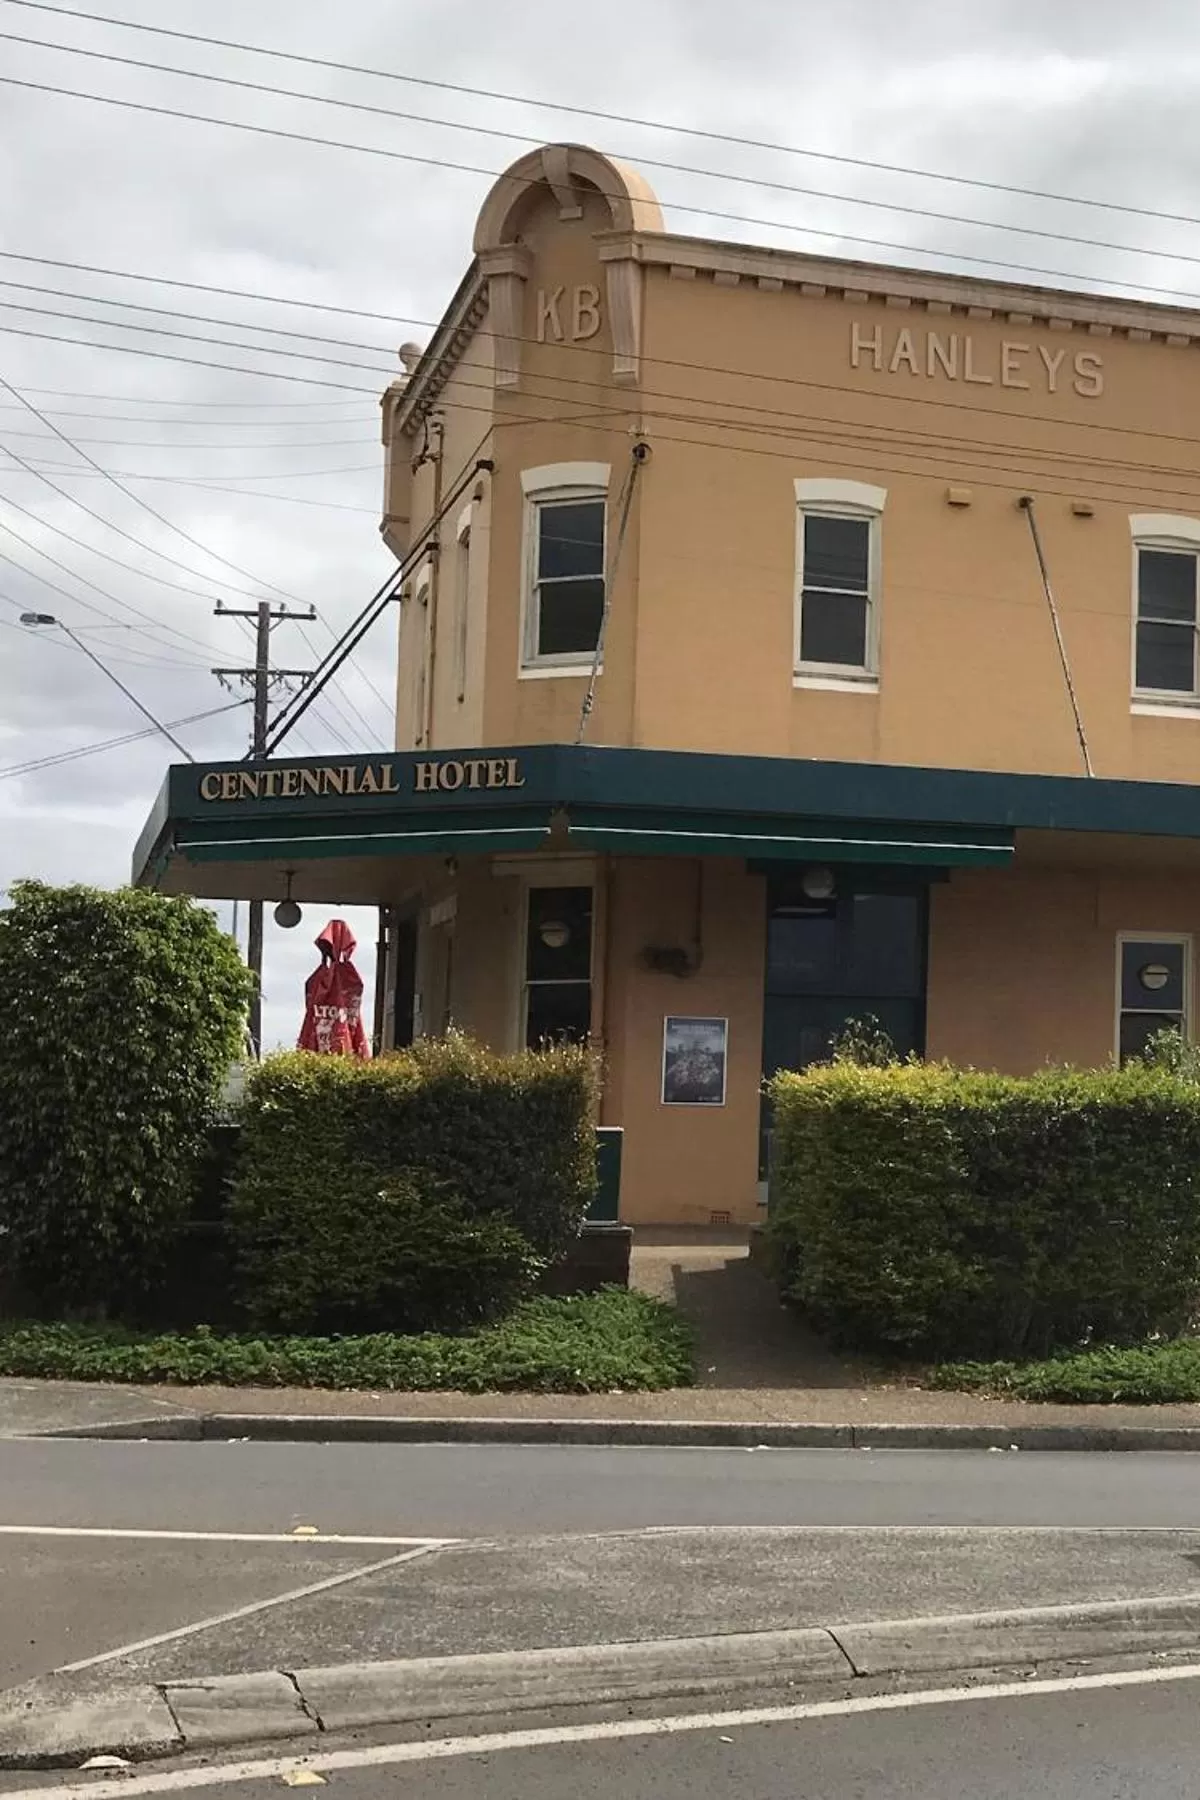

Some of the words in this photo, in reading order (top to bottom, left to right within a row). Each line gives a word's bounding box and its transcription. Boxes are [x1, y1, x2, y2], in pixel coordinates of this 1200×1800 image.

[536, 284, 600, 343] KB
[850, 321, 1104, 397] HANLEYS
[201, 764, 399, 800] CENTENNIAL
[415, 758, 525, 792] HOTEL
